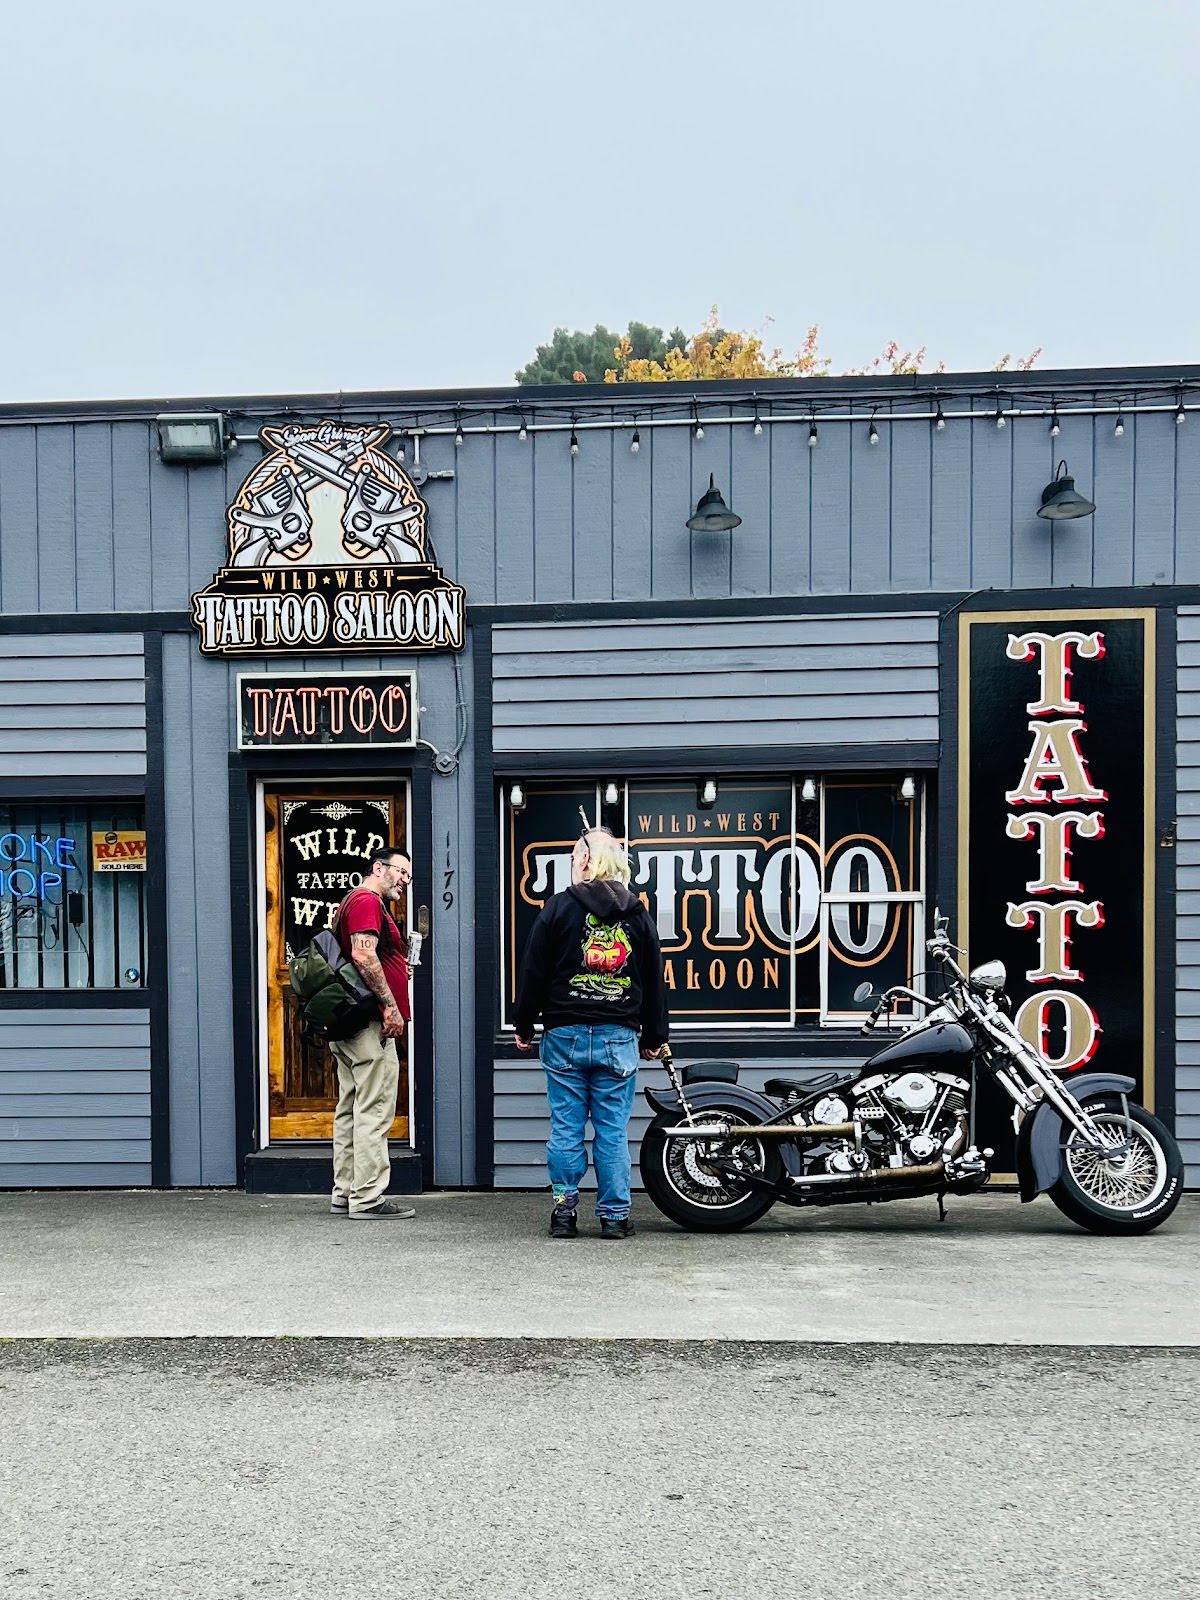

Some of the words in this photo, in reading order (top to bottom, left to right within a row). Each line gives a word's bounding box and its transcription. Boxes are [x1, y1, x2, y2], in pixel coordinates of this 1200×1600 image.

[262, 573, 317, 590] WILD
[335, 570, 394, 588] WEST
[198, 595, 325, 648] TATTOO
[336, 590, 461, 646] SALOON
[248, 685, 407, 736] TATTOO
[638, 814, 697, 833] WILD
[717, 812, 780, 832] WEST
[95, 840, 146, 859] RAW
[1005, 631, 1107, 1100] TATTO
[297, 872, 363, 889] TATTO
[532, 846, 889, 955] TTOO
[664, 957, 779, 990] ALOON
